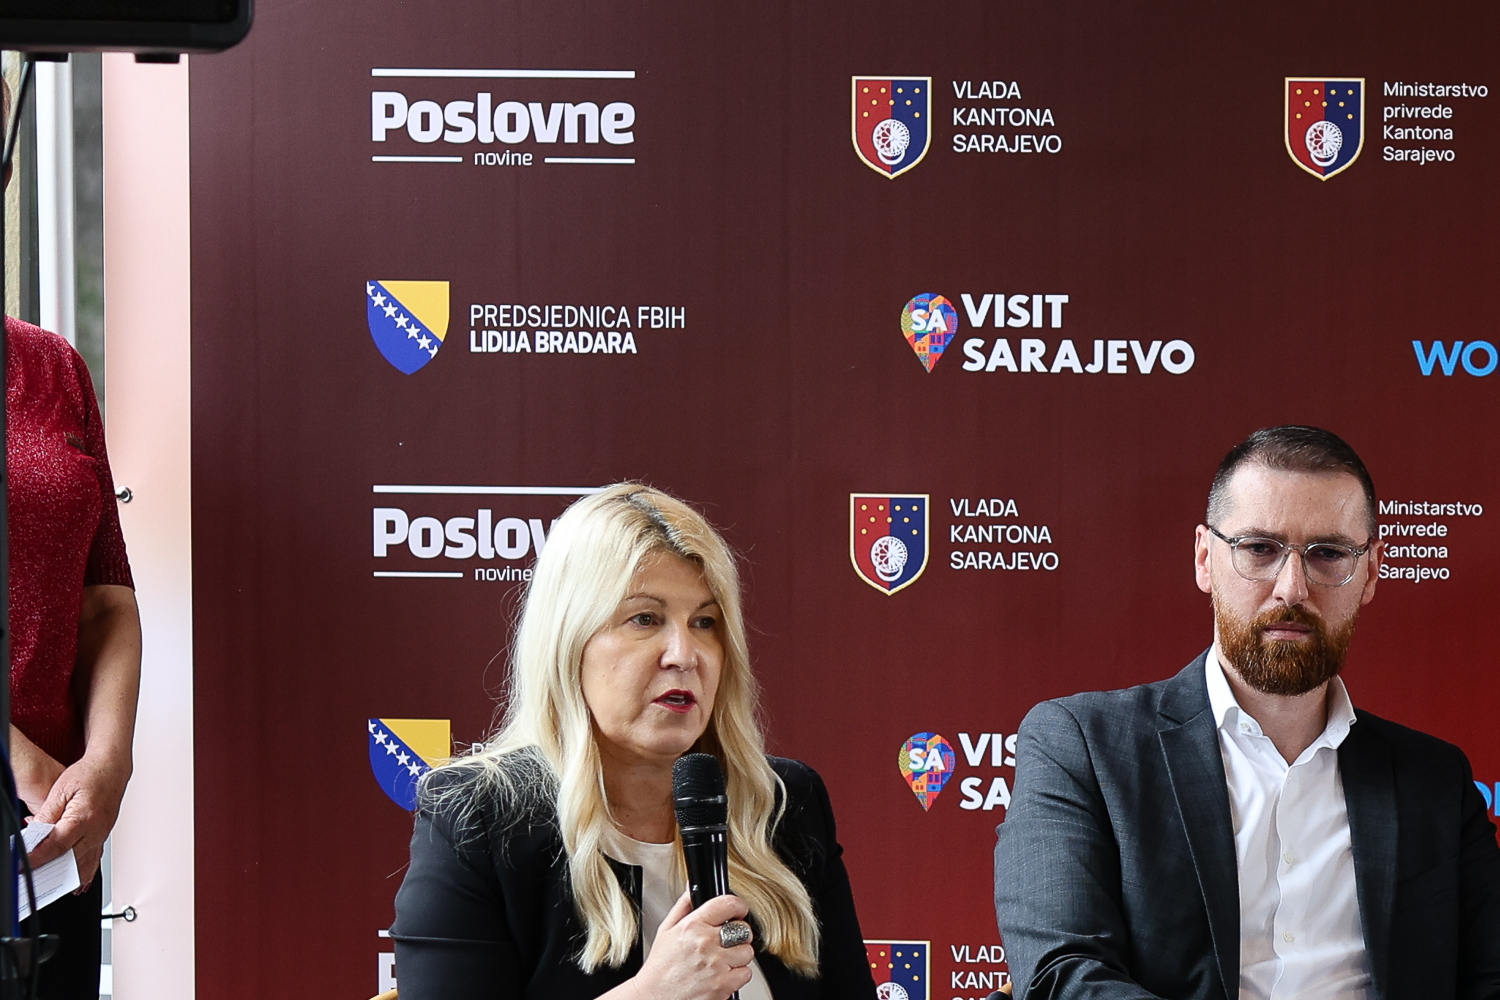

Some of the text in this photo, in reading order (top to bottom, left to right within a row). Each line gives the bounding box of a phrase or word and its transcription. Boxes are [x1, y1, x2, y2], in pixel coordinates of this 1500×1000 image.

[952, 80, 1022, 100] VLADA
[1383, 81, 1489, 98] Ministarstvo
[371, 91, 636, 145] Poslovne
[953, 107, 1055, 127] KANTONA
[1383, 103, 1453, 122] privrede
[1383, 124, 1453, 141] Kantona
[952, 133, 1062, 154] SARAJEVO
[474, 149, 533, 166] novine
[1383, 145, 1456, 166] Sarajevo
[470, 304, 685, 329] PREDSJEDNICA FBIH
[910, 309, 945, 333] SA
[960, 293, 1069, 329] VISIT
[470, 330, 638, 354] LIDIJA BRADARA
[962, 338, 1195, 375] SARAJEVO
[950, 498, 1019, 517] VLADA
[1378, 500, 1483, 516] Ministarstvo
[373, 508, 558, 560] Poslov
[950, 524, 1052, 544] KANTONA
[1378, 521, 1448, 541] privrede
[950, 550, 1059, 571] SARAJEVO
[475, 566, 532, 582] novine
[1378, 563, 1450, 584] Sarajevo
[908, 748, 945, 770] SA
[958, 733, 1017, 767] VIS
[950, 945, 1007, 963] VLAD
[951, 971, 1010, 989] KANT
